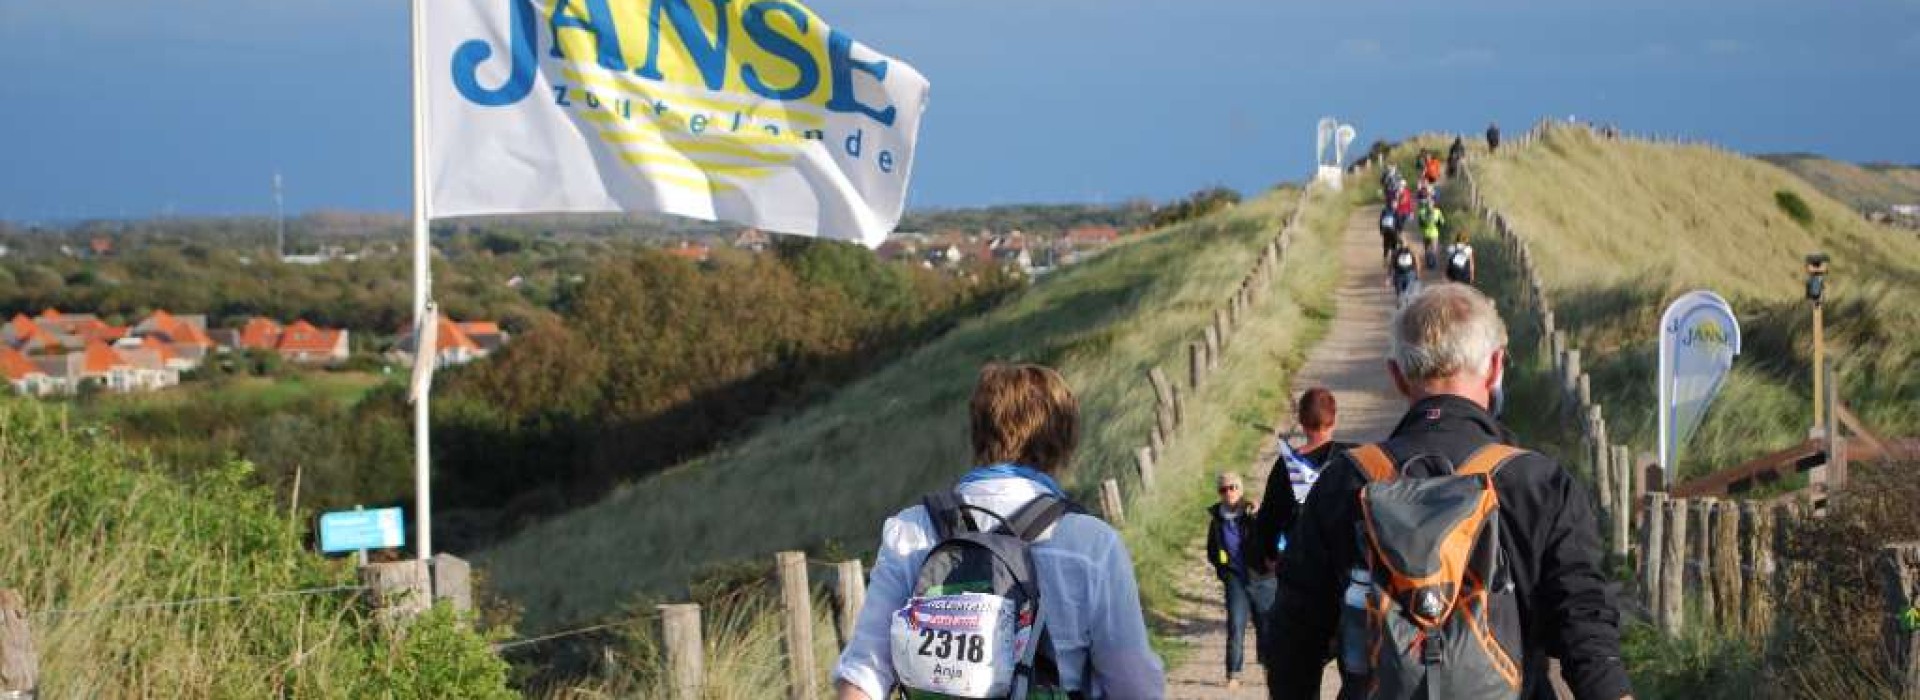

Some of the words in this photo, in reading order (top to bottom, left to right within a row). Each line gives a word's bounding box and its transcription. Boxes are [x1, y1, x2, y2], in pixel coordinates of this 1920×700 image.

[450, 0, 895, 126] JANSE
[918, 628, 985, 663] 2318
[933, 663, 963, 679] Anja
